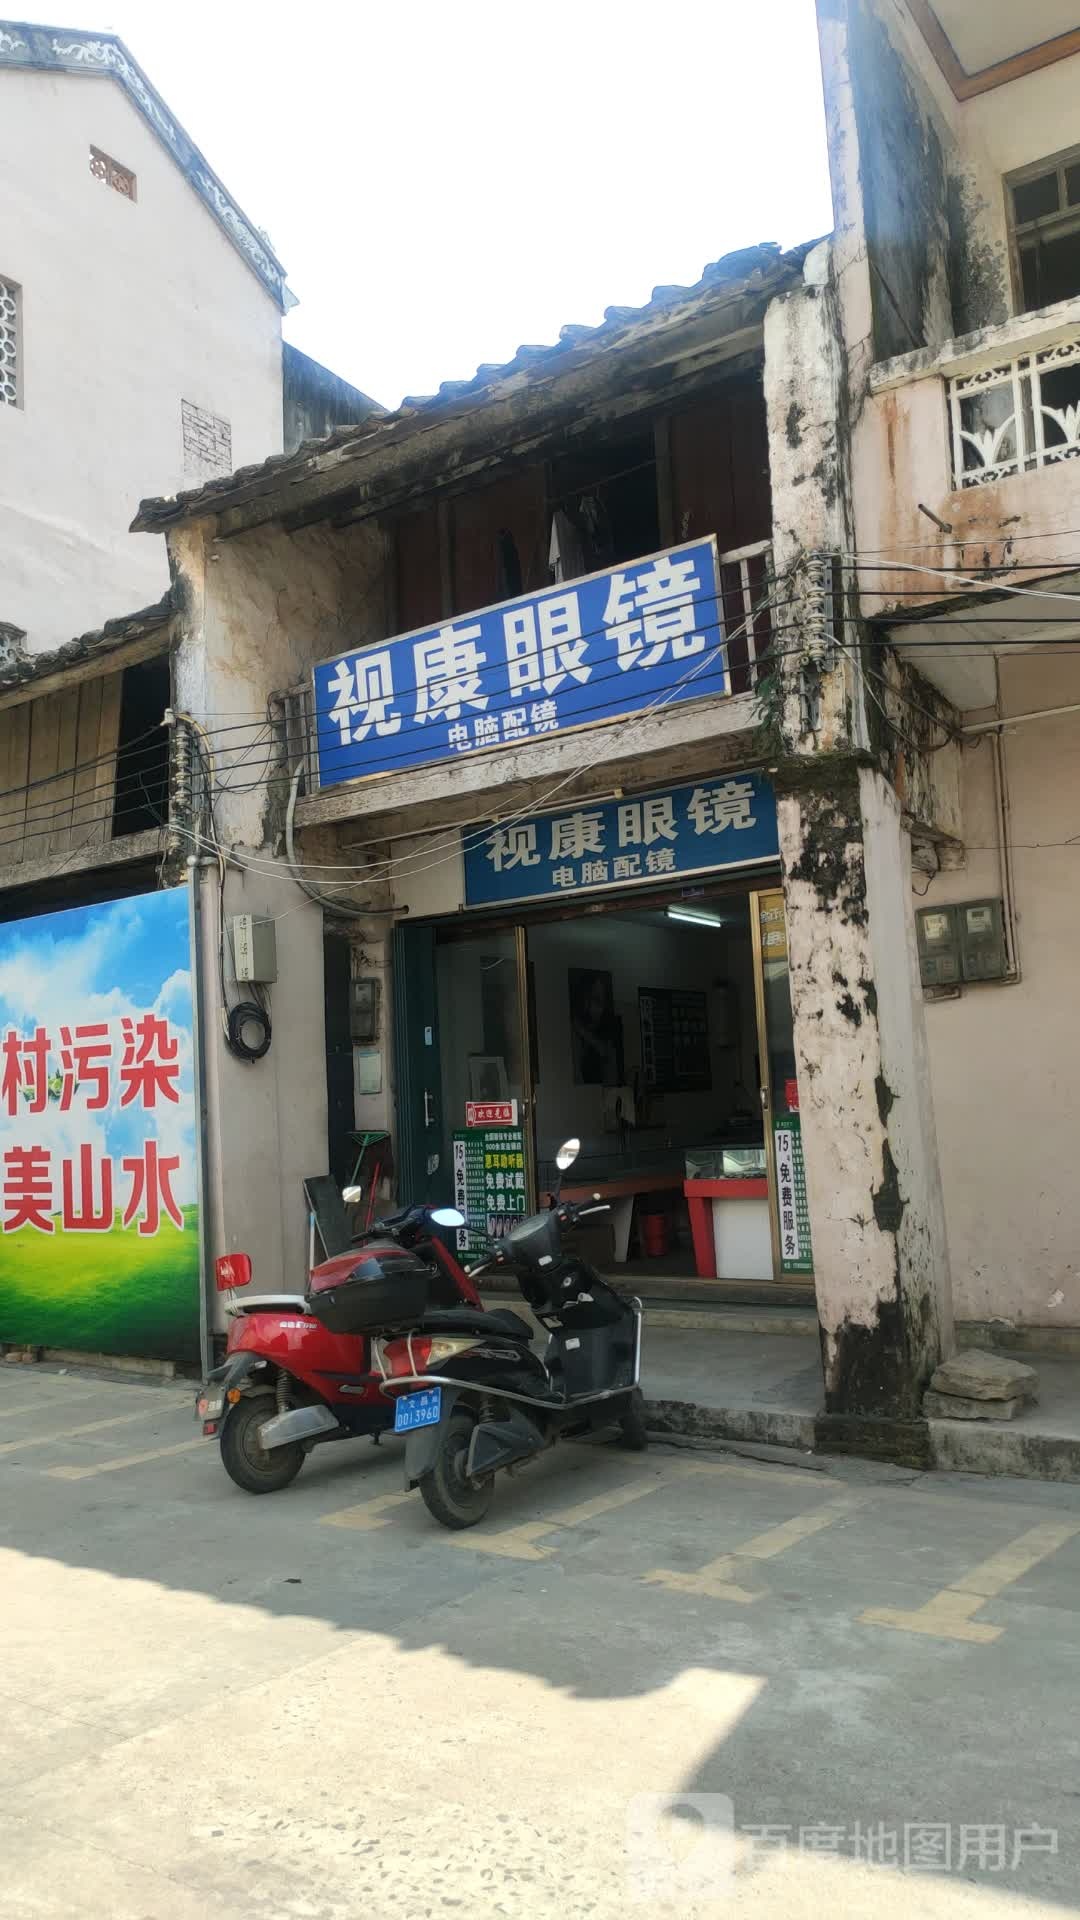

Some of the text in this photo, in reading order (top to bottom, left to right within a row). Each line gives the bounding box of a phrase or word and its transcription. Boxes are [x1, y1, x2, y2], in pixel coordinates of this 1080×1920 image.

[328, 558, 705, 746] 视康眼镜
[448, 699, 559, 751] 电脑配镜
[485, 781, 757, 872] 视康眼镜
[552, 848, 677, 888] 电脑配镜
[1, 1014, 180, 1117] 村污染
[3, 1140, 183, 1234] 美山水
[486, 1172, 525, 1190] 免费试戴
[486, 1193, 526, 1211] 免费上门
